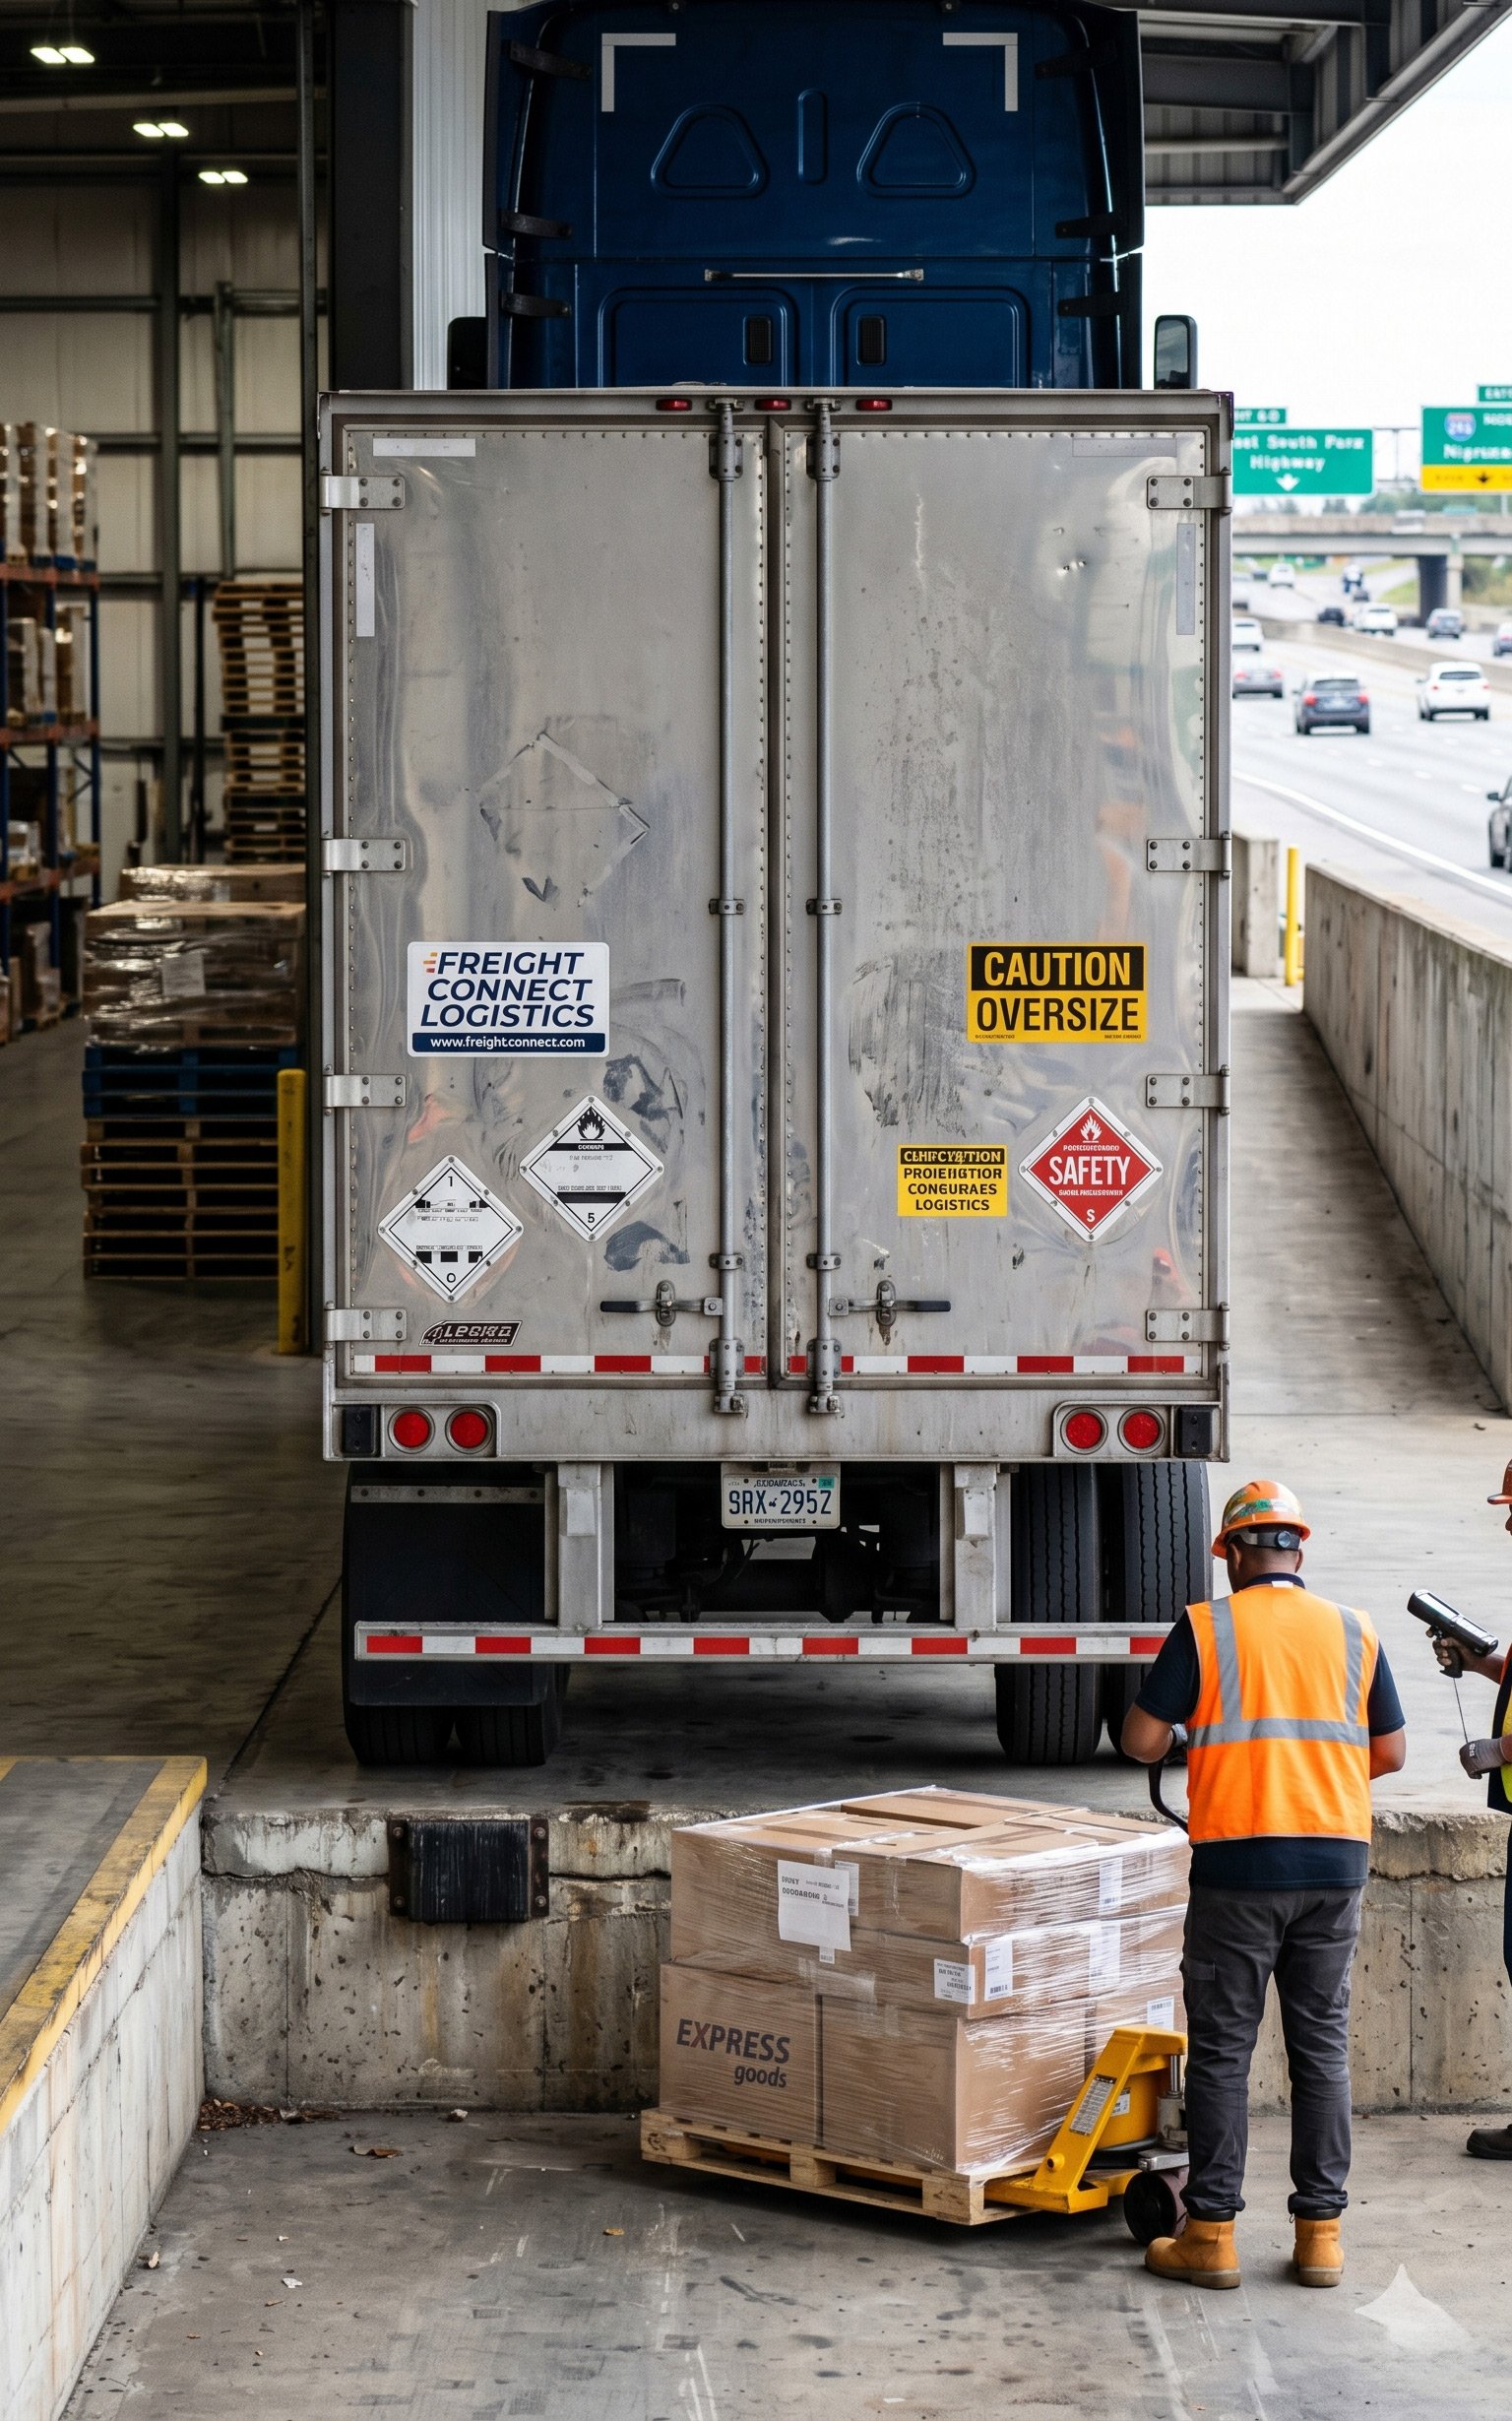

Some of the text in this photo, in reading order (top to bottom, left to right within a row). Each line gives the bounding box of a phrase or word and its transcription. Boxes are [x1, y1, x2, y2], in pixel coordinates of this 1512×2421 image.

[1266, 434, 1317, 450] South
[1249, 455, 1326, 474] Highway
[438, 952, 585, 975] FREIGHT
[984, 951, 1131, 987] CAUTION
[427, 979, 593, 1001] CONNECT
[420, 1004, 595, 1027] LOGISTICS
[976, 997, 1139, 1032] OVERSIZE
[1048, 1156, 1131, 1185] SAFETY
[915, 1199, 990, 1211] LOGISTICS
[1086, 1208, 1096, 1223] S
[587, 1212, 596, 1224] 5
[676, 2018, 790, 2064] EXPRESS
[734, 2066, 787, 2088] goods
